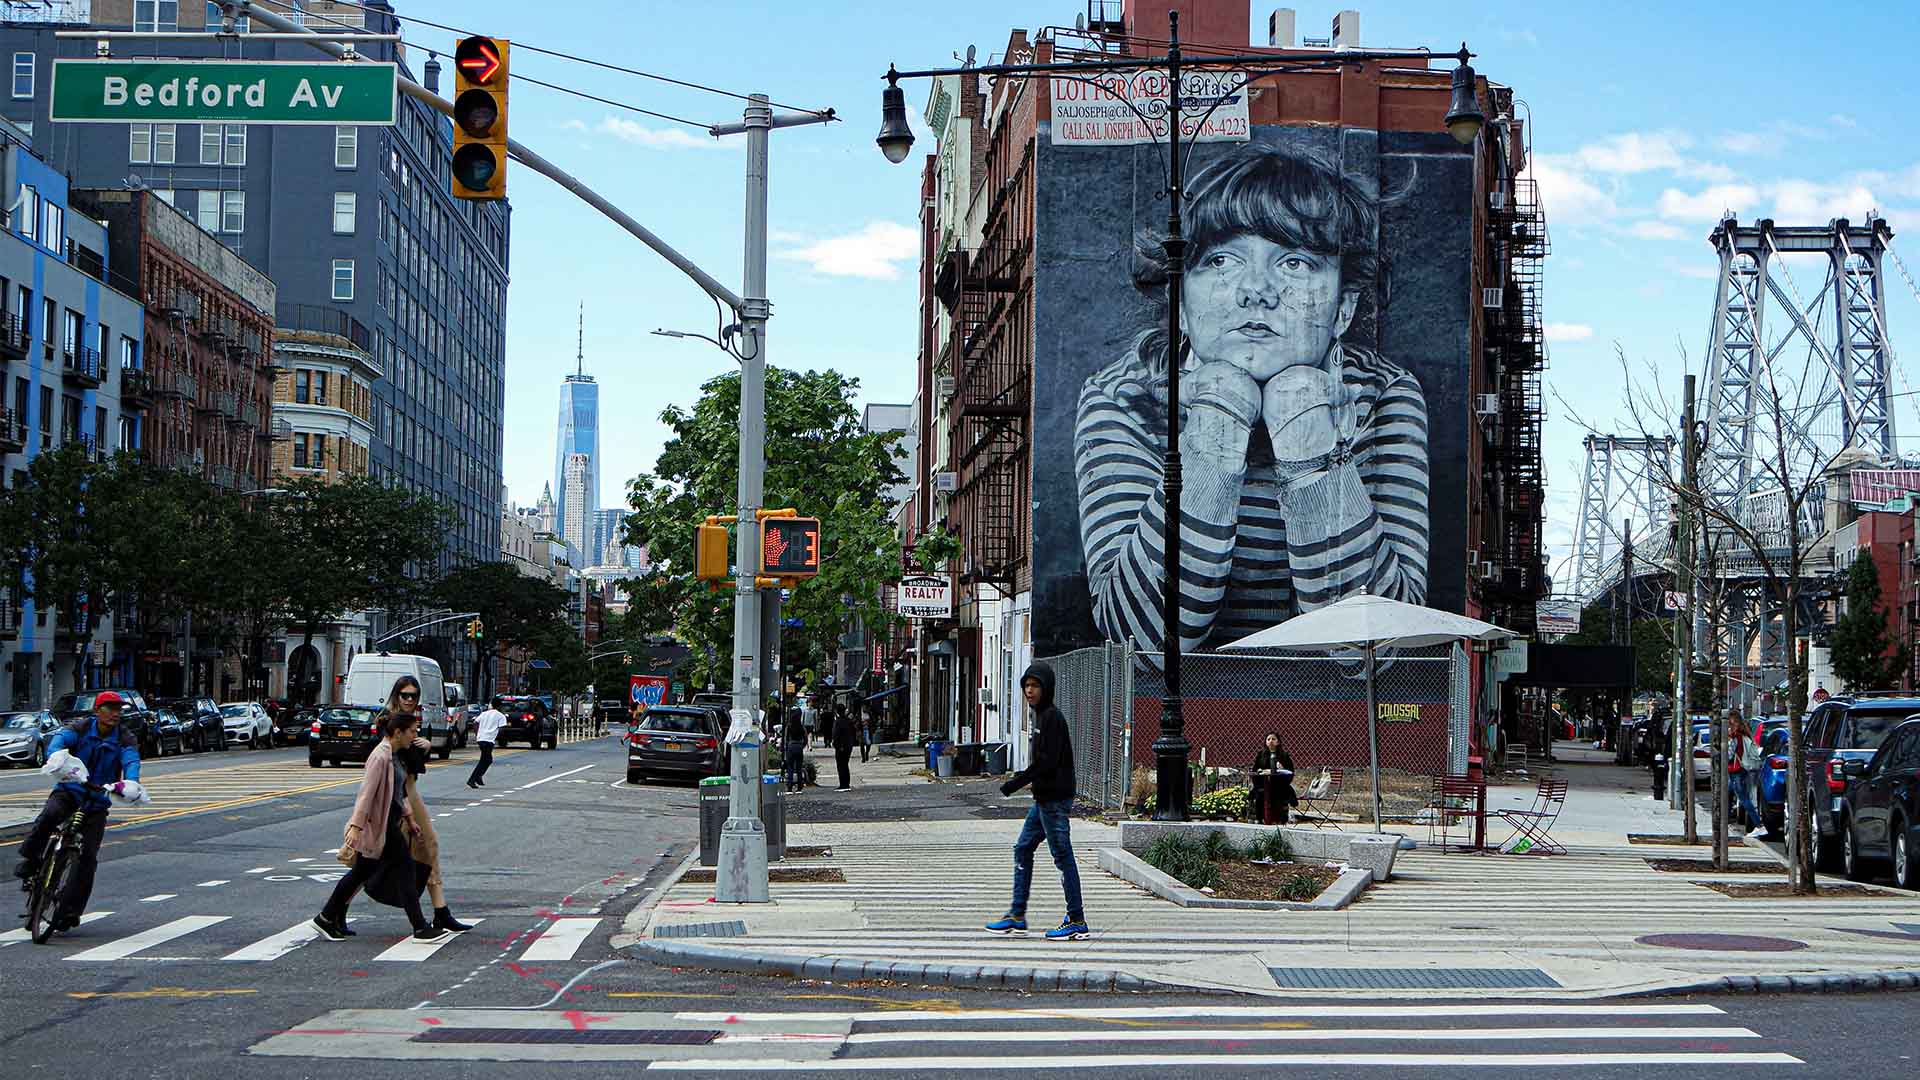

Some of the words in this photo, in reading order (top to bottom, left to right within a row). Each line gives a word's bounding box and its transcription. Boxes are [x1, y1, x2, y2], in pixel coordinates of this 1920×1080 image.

[104, 77, 265, 107] Bedford
[289, 78, 343, 108] Av
[1056, 79, 1087, 100] LOT
[1094, 79, 1128, 100] FOR
[1132, 76, 1170, 99] SALE
[1057, 103, 1169, 118] SALJOSEPH@CRISI.COM
[1063, 122, 1084, 140] CALL
[1086, 122, 1101, 140] SAL
[1104, 121, 1133, 139] JOSEPH
[804, 531, 817, 566] 3
[904, 587, 945, 599] REALTY
[1378, 703, 1420, 720] COLOSSAL
